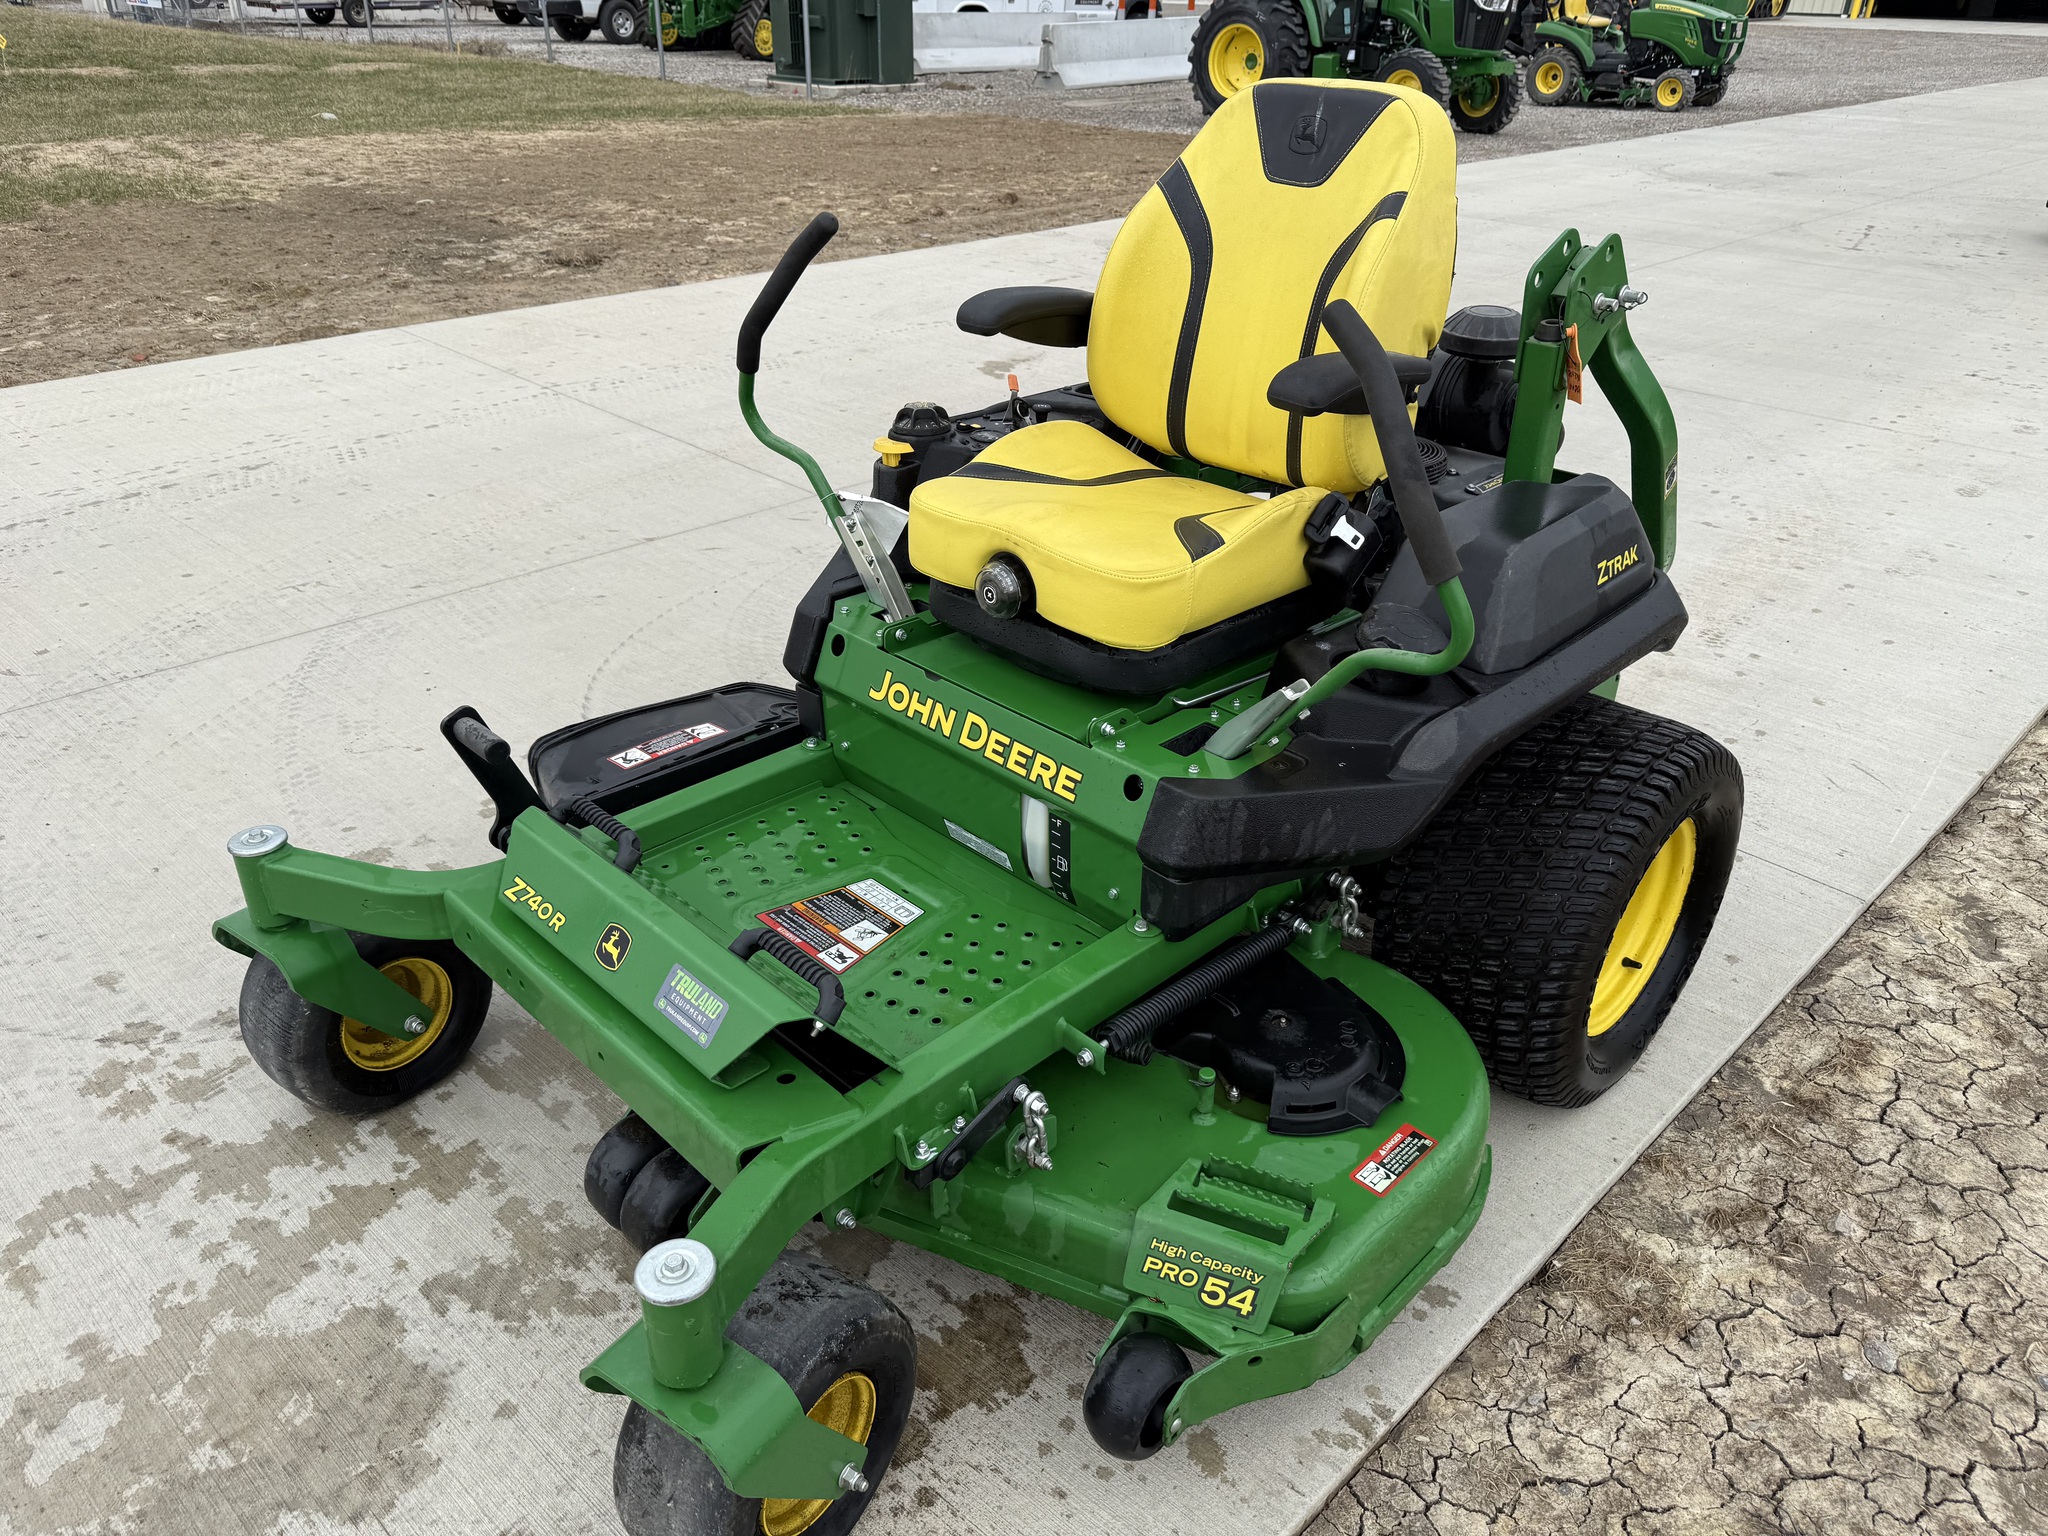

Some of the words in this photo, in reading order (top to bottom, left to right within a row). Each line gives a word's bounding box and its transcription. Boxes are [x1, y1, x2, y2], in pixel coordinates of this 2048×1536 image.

[1597, 544, 1638, 585] ZTRAK
[868, 669, 957, 738] JOHN
[958, 710, 1083, 803] DEERE
[671, 969, 724, 1019] TRULAND
[671, 993, 707, 1024] EQUIPMENT
[1382, 1132, 1404, 1151] DANGER
[1382, 1147, 1402, 1164] ROTATING
[1399, 1136, 1413, 1148] BLADE
[1150, 1237, 1187, 1259] High
[1189, 1251, 1266, 1285] Capacity
[1142, 1255, 1199, 1287] PRO
[1200, 1274, 1258, 1317] 54
